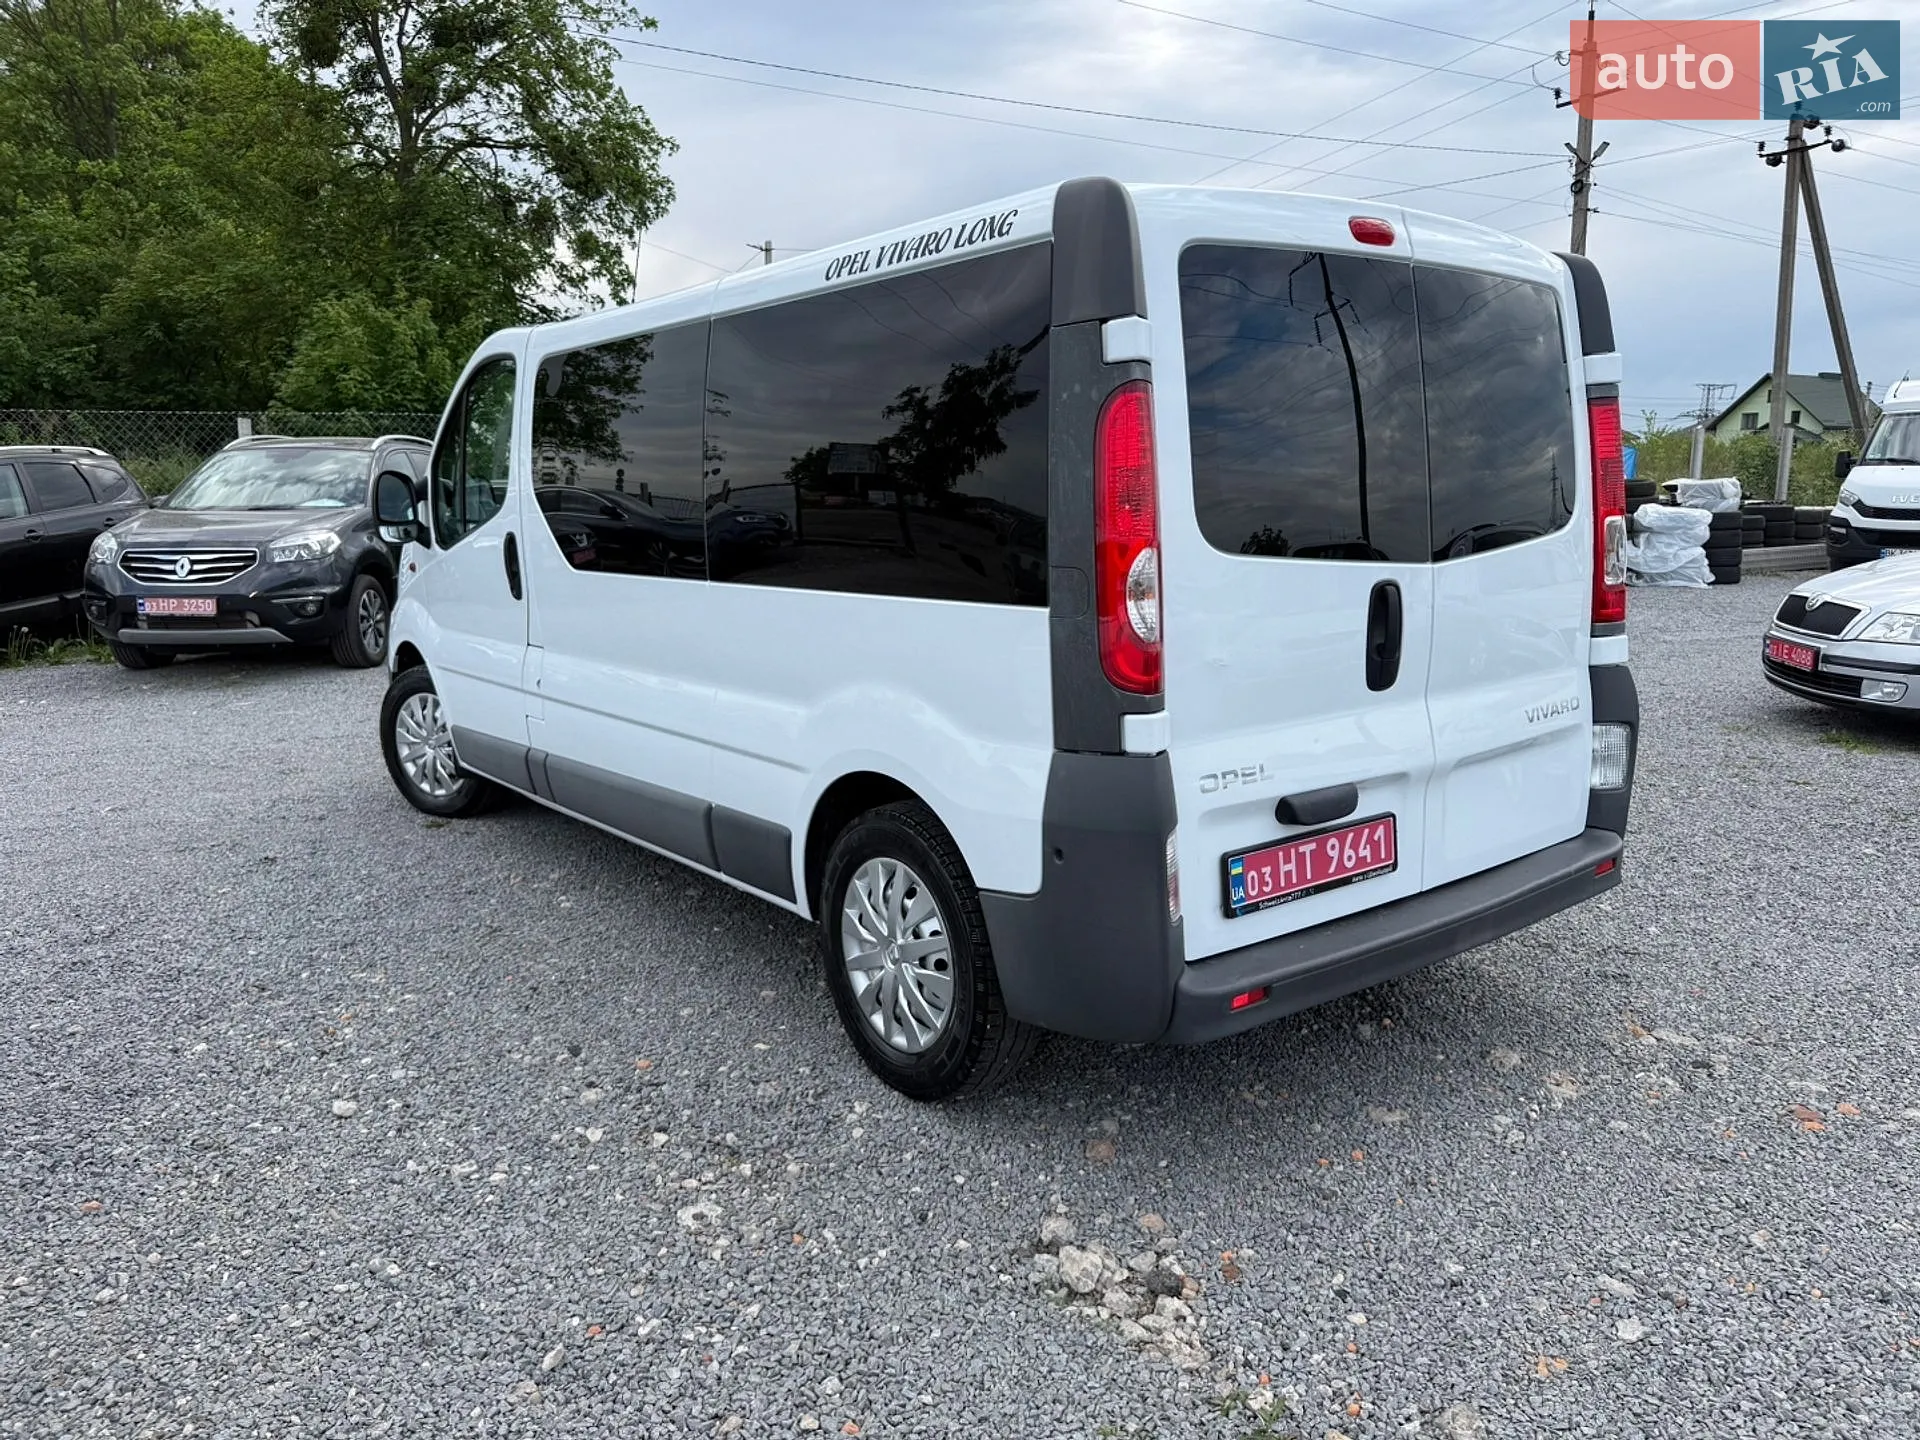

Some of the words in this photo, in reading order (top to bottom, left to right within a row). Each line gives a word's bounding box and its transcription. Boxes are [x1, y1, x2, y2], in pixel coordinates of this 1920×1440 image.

[825, 249, 871, 281] OPEL
[876, 227, 953, 270] VIVARO
[953, 209, 1019, 249] LONG
[160, 598, 178, 612] HP
[183, 599, 213, 612] 3250
[1525, 696, 1581, 724] VIVARO
[1199, 763, 1276, 795] OPEL
[1247, 866, 1273, 896] 03
[1279, 842, 1317, 888] HT
[1326, 824, 1386, 875] 9641
[1231, 886, 1246, 902] UA
